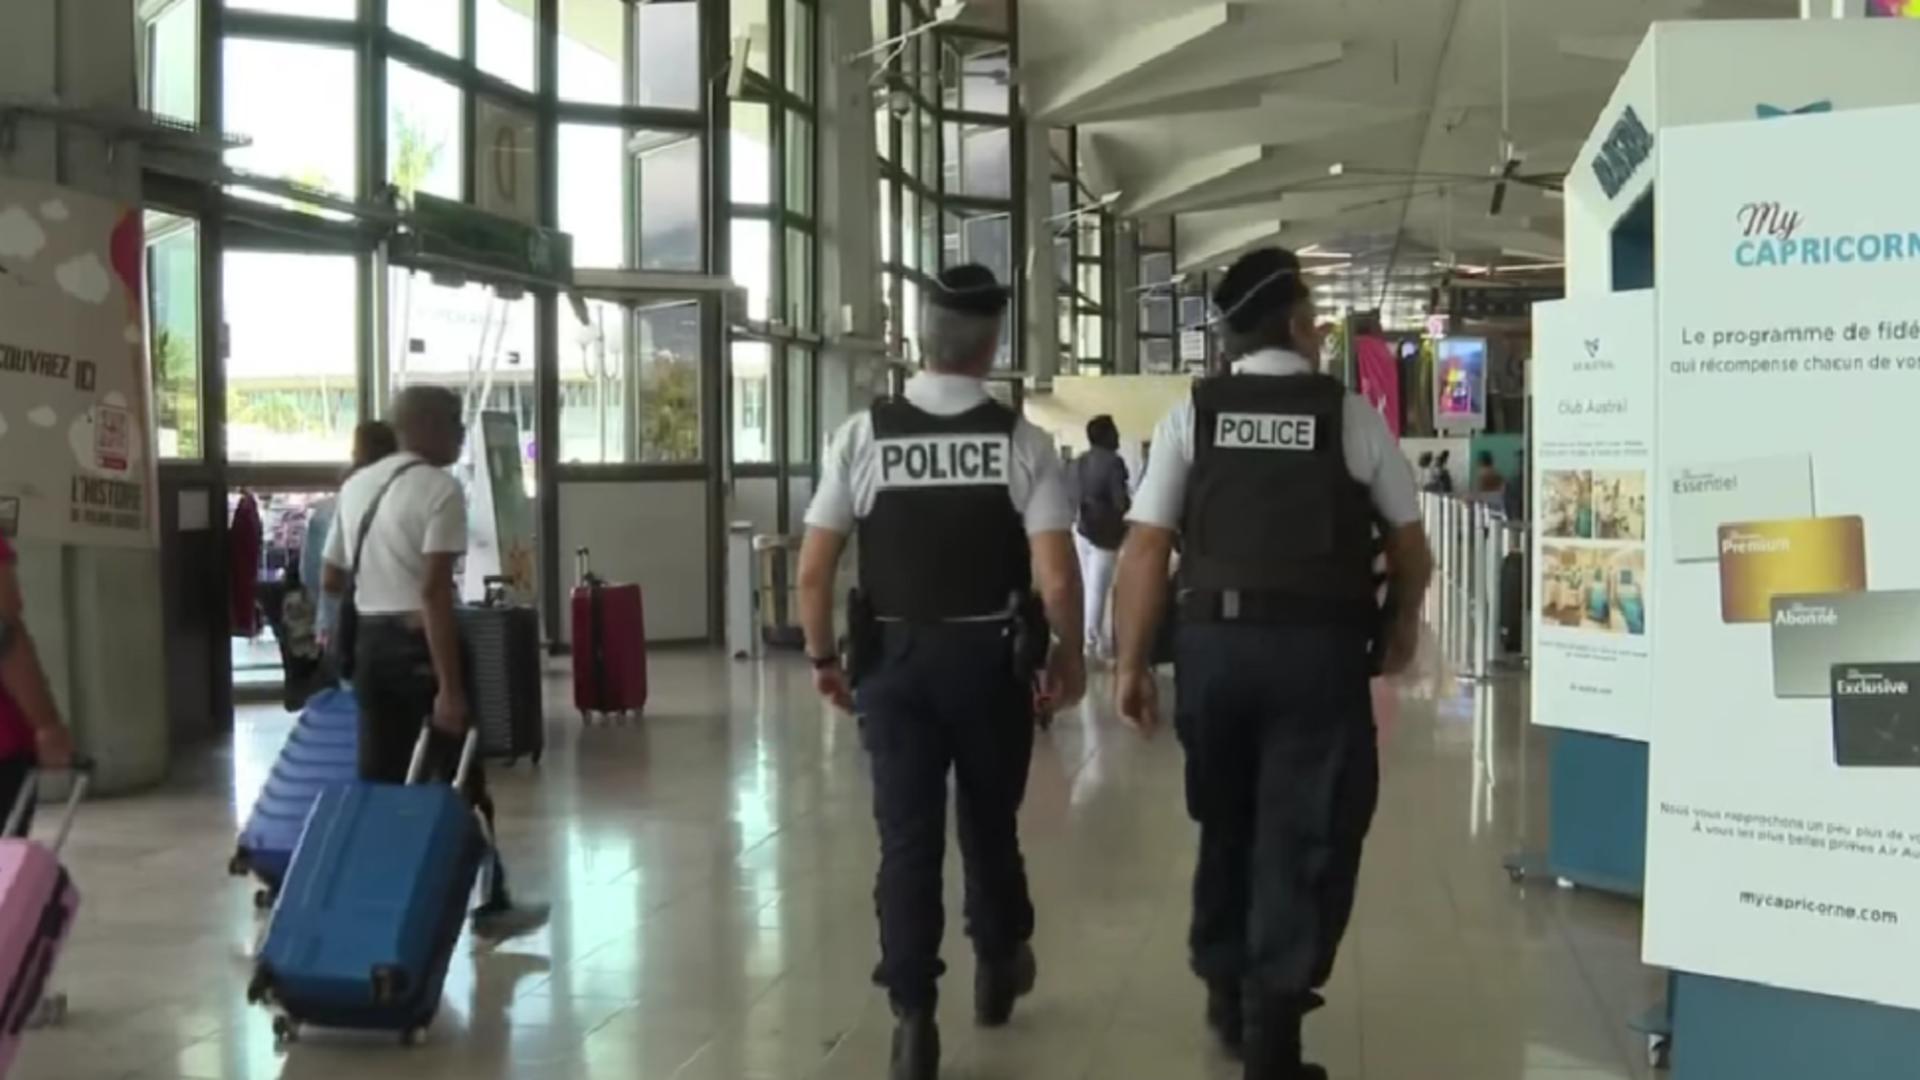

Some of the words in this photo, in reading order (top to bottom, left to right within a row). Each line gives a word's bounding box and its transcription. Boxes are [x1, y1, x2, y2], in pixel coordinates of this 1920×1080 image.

[1737, 202, 1803, 241] My
[1682, 327, 1705, 344] Le
[1713, 326, 1835, 348] programme
[1843, 322, 1870, 341] de
[1670, 358, 1696, 374] qui
[1701, 357, 1798, 374] récompense
[1803, 356, 1863, 373] chacun
[1868, 354, 1891, 371] de
[1220, 418, 1310, 446] POLICE
[882, 442, 1003, 481] POLICE
[1672, 475, 1738, 494] Essentiel
[1722, 538, 1790, 554] Premium
[1775, 609, 1838, 626] Abonné
[1837, 678, 1908, 695] Exclusive
[1660, 802, 1690, 817] Nous
[1693, 808, 1721, 820] vous
[1724, 811, 1804, 831] rapprochons
[1807, 821, 1823, 832] un
[1827, 823, 1850, 836] peu
[1856, 826, 1883, 839] plus
[1887, 829, 1903, 840] de
[1706, 826, 1734, 837] vous
[1738, 826, 1754, 839] les
[1788, 832, 1826, 849] belles
[1829, 838, 1874, 854] primes
[1740, 891, 1898, 924] mycapricorne.com
